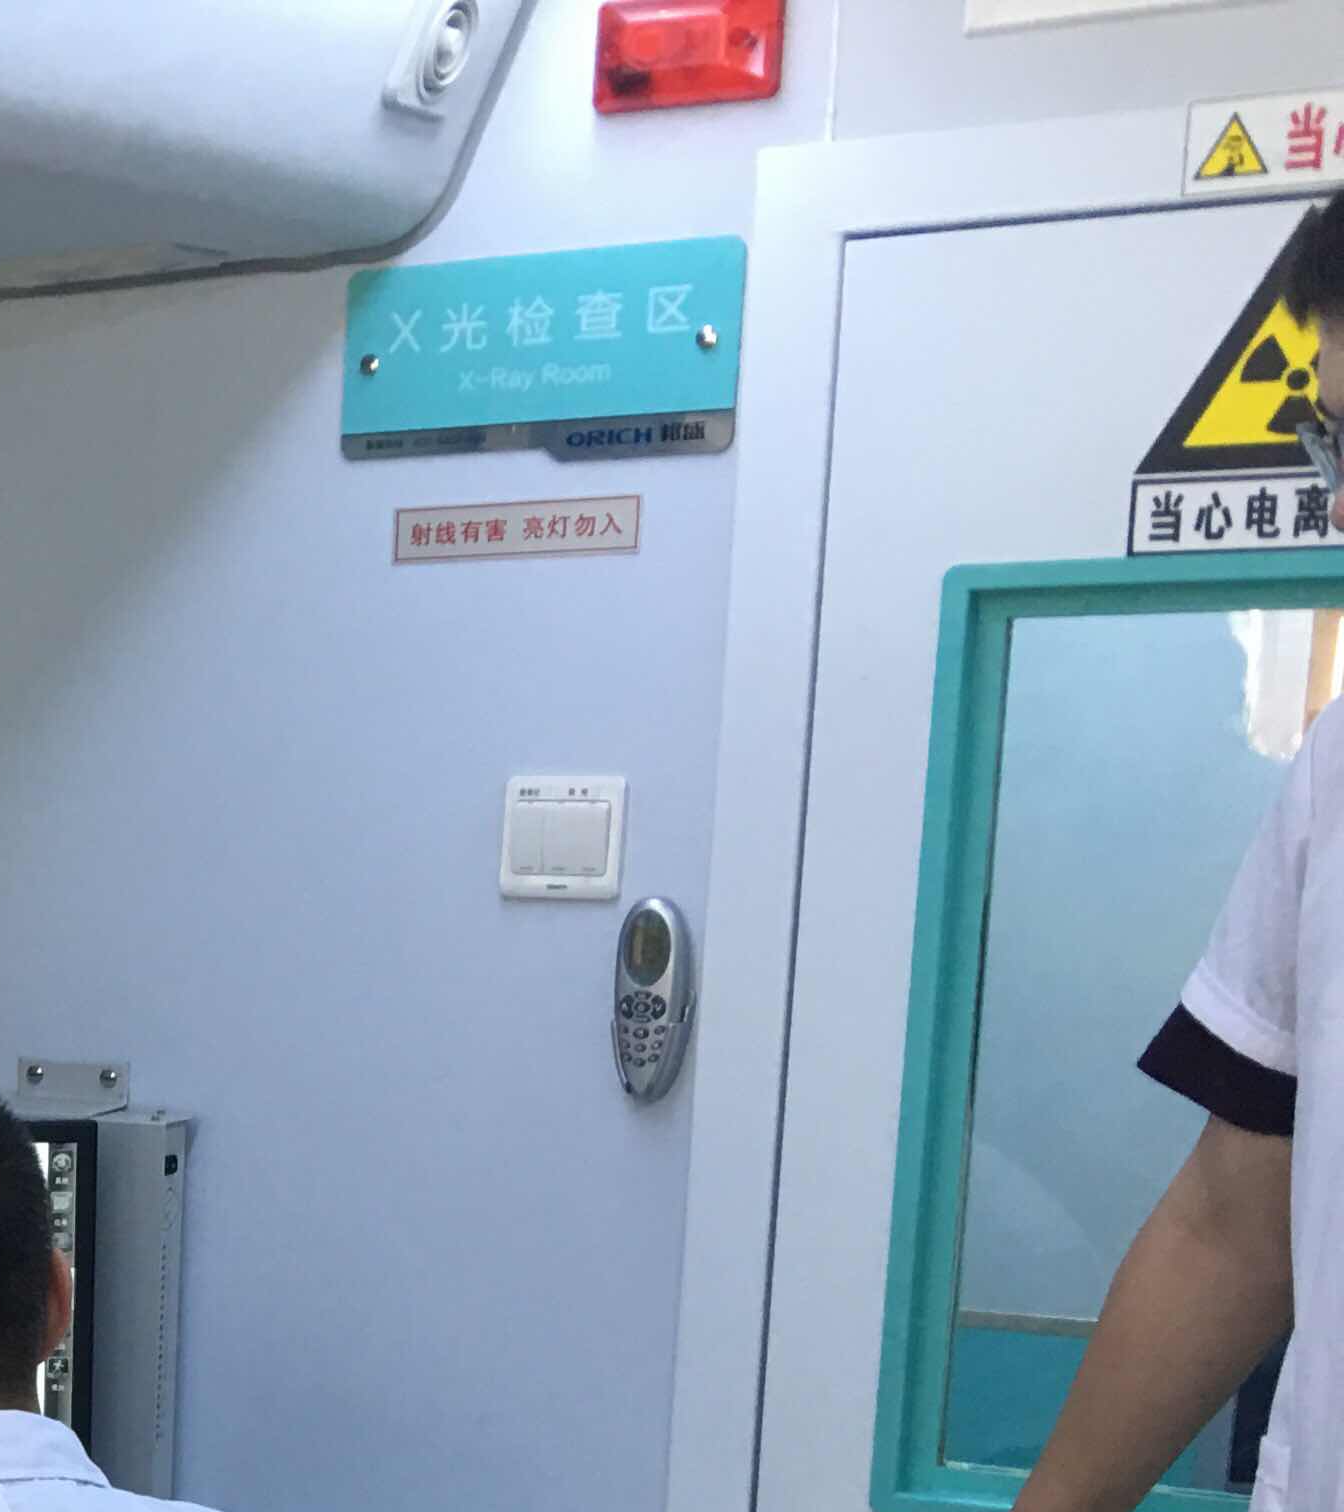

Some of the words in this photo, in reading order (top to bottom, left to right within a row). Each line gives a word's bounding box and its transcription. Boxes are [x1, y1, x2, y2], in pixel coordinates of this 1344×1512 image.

[389, 284, 693, 353] X光检查区
[458, 367, 533, 392] X-Ray
[542, 361, 611, 385] Room
[566, 427, 652, 448] ORICH
[411, 519, 508, 546] 射线有害
[523, 512, 623, 541] 亮灯勿入
[1149, 484, 1330, 543] 当心电离
